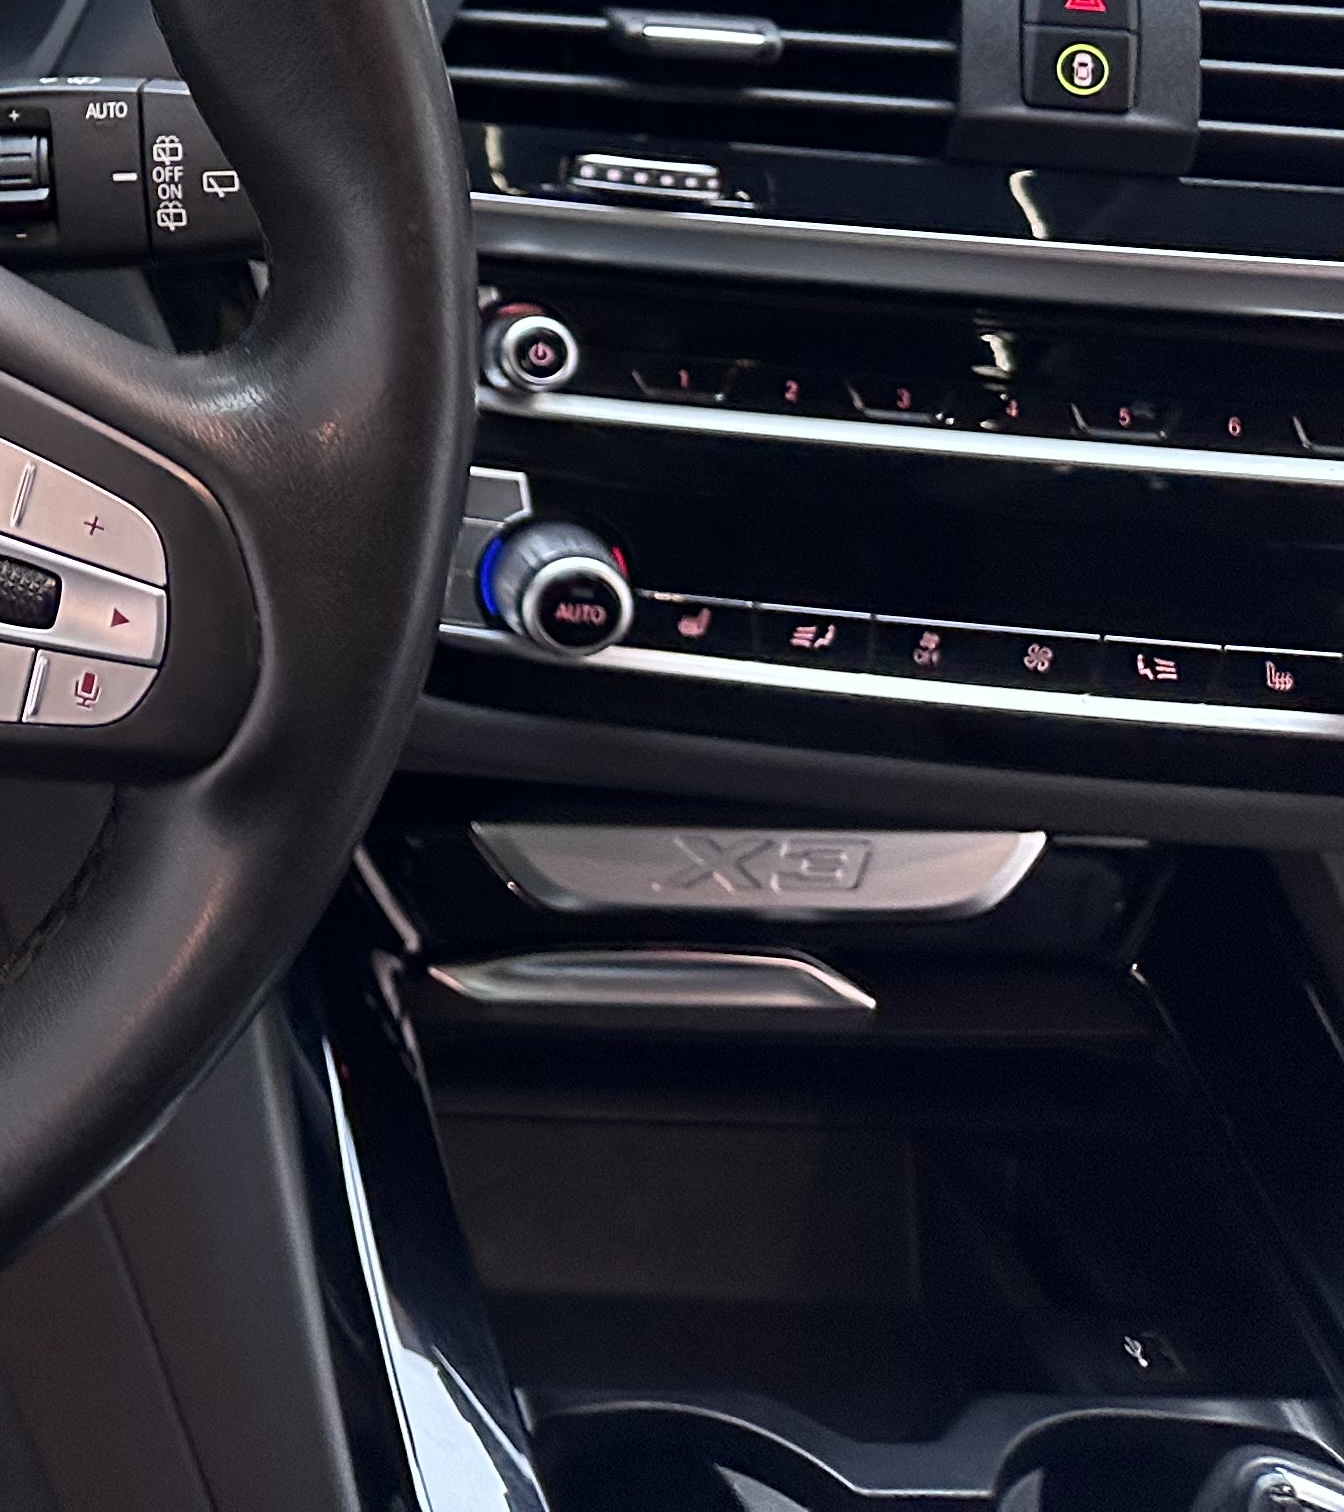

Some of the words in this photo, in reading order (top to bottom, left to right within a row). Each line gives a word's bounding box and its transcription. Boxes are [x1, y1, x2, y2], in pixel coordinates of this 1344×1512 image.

[85, 101, 128, 120] AUTO
[152, 166, 183, 183] OFF
[158, 184, 182, 200] ON
[1228, 415, 1243, 438] 6
[554, 601, 609, 627] AUTO
[651, 833, 874, 892] X3
